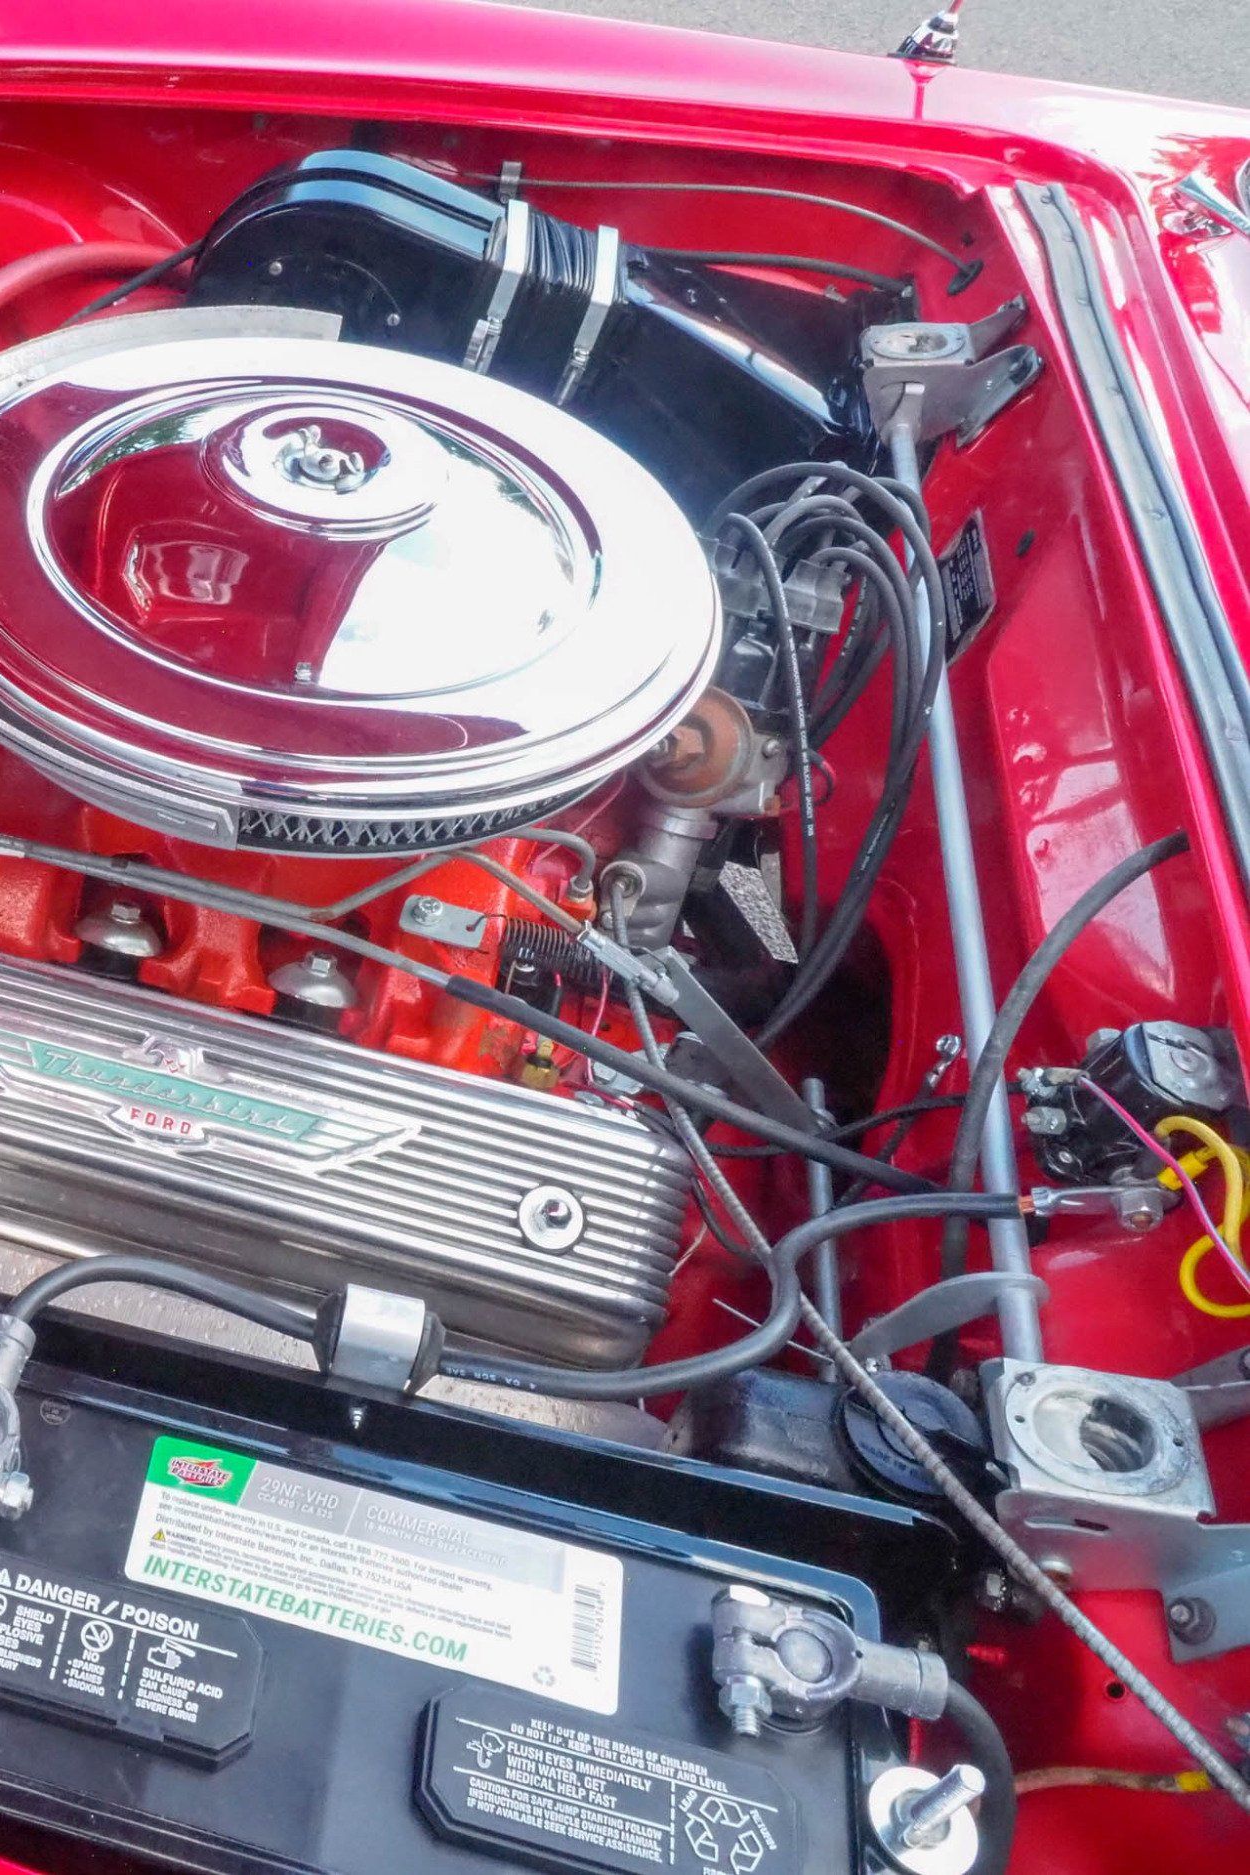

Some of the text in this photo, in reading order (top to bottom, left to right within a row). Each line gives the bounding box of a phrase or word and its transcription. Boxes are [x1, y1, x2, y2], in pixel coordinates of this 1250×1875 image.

[47, 1051, 295, 1135] Thunderbird
[130, 1106, 192, 1135] FORD
[171, 1458, 229, 1480] INTERSTATE
[171, 1466, 223, 1486] BATTERIES
[260, 1476, 337, 1509] 29NF-VHD
[223, 1509, 256, 1525] warranty
[284, 1526, 298, 1536] and
[366, 1504, 470, 1545] COMMERCIAL
[155, 1512, 201, 1533] Distributed
[202, 1526, 213, 1538] by
[215, 1529, 255, 1548] Interstate
[351, 1567, 362, 1577] TX
[393, 1578, 412, 1591] USA
[11, 1615, 42, 1632] EYES
[14, 1573, 101, 1612] DANGER
[119, 1603, 200, 1640] POISON
[15, 1604, 55, 1624] SHIELD
[143, 1553, 467, 1664] INTERSTATEBATTERIES.COM
[81, 1649, 100, 1662] NO
[137, 1687, 199, 1712] BLINDNESS OR
[138, 1678, 188, 1699] CAN CAUSE
[140, 1667, 223, 1699] SULFURIC ACID
[134, 1697, 167, 1714] SEVERE
[506, 1740, 652, 1792] FLUSH EYES IMMEDIATELY
[510, 1722, 523, 1734] DO
[523, 1726, 545, 1740] NOT
[566, 1738, 591, 1754] KEEP
[591, 1745, 618, 1761] VENT
[618, 1753, 645, 1769] CAPS
[645, 1761, 675, 1778] TIGHT
[675, 1769, 698, 1784] AND
[698, 1776, 729, 1793] LEVEL
[530, 1718, 708, 1777] KEEP OUT OF THE REACH OF CHILDREN
[504, 1767, 617, 1809] MEDICAL HELP FAST
[505, 1754, 536, 1773] WITH
[583, 1776, 607, 1793] GET
[468, 1786, 532, 1814] INSTRUCTIONS
[532, 1806, 542, 1816] IN
[543, 1808, 580, 1828] VEHICLE
[581, 1820, 619, 1839] OWNERS
[469, 1776, 662, 1841] CAUTION: FOR SAFE JUMP STARTING FOLLOW
[678, 1788, 699, 1813] LEAD
[466, 1797, 478, 1808] IF
[478, 1800, 496, 1813] NOT
[496, 1805, 542, 1827] AVAILABLE
[542, 1819, 566, 1834] SEEK
[566, 1826, 606, 1846] SERVICE
[750, 1808, 778, 1850] RETURN
